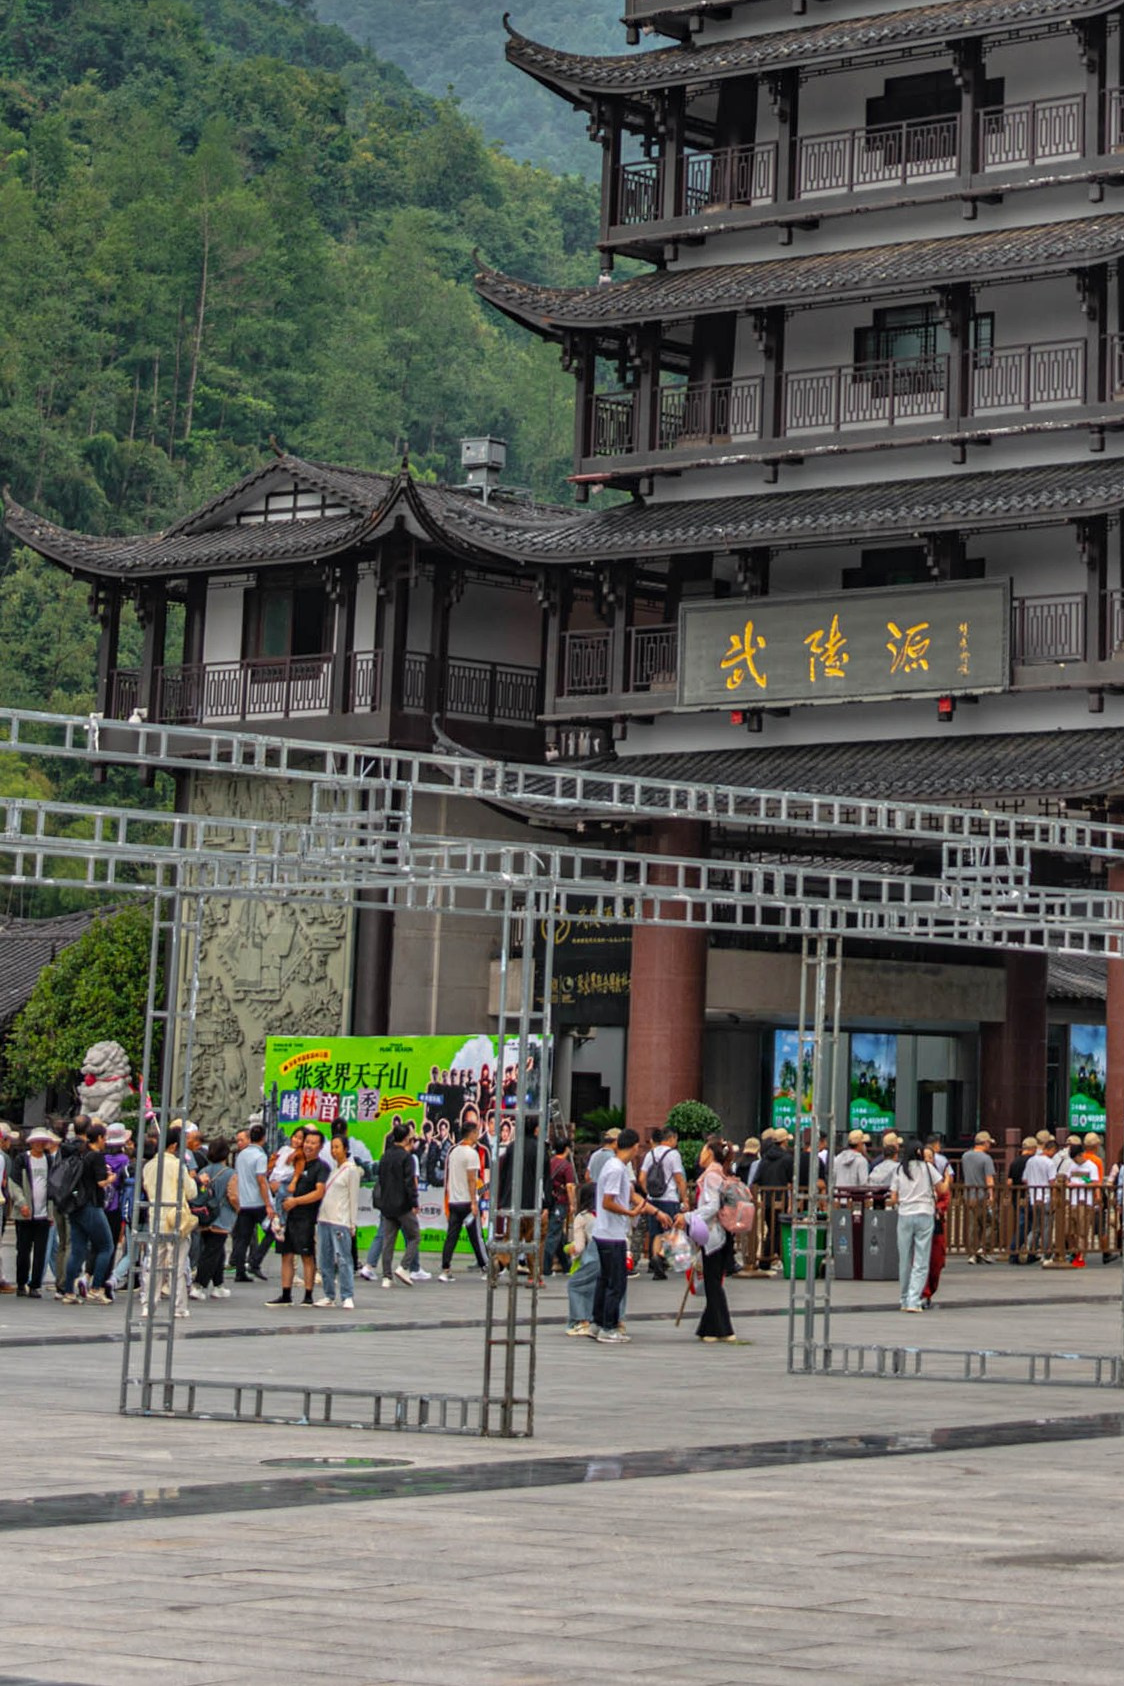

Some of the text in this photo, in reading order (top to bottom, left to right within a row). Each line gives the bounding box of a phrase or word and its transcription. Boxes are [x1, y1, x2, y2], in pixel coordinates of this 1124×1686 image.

[720, 614, 931, 690] 武陵源
[294, 1061, 408, 1091] 张家界天子山
[281, 1089, 378, 1122] 峰林音乐季
